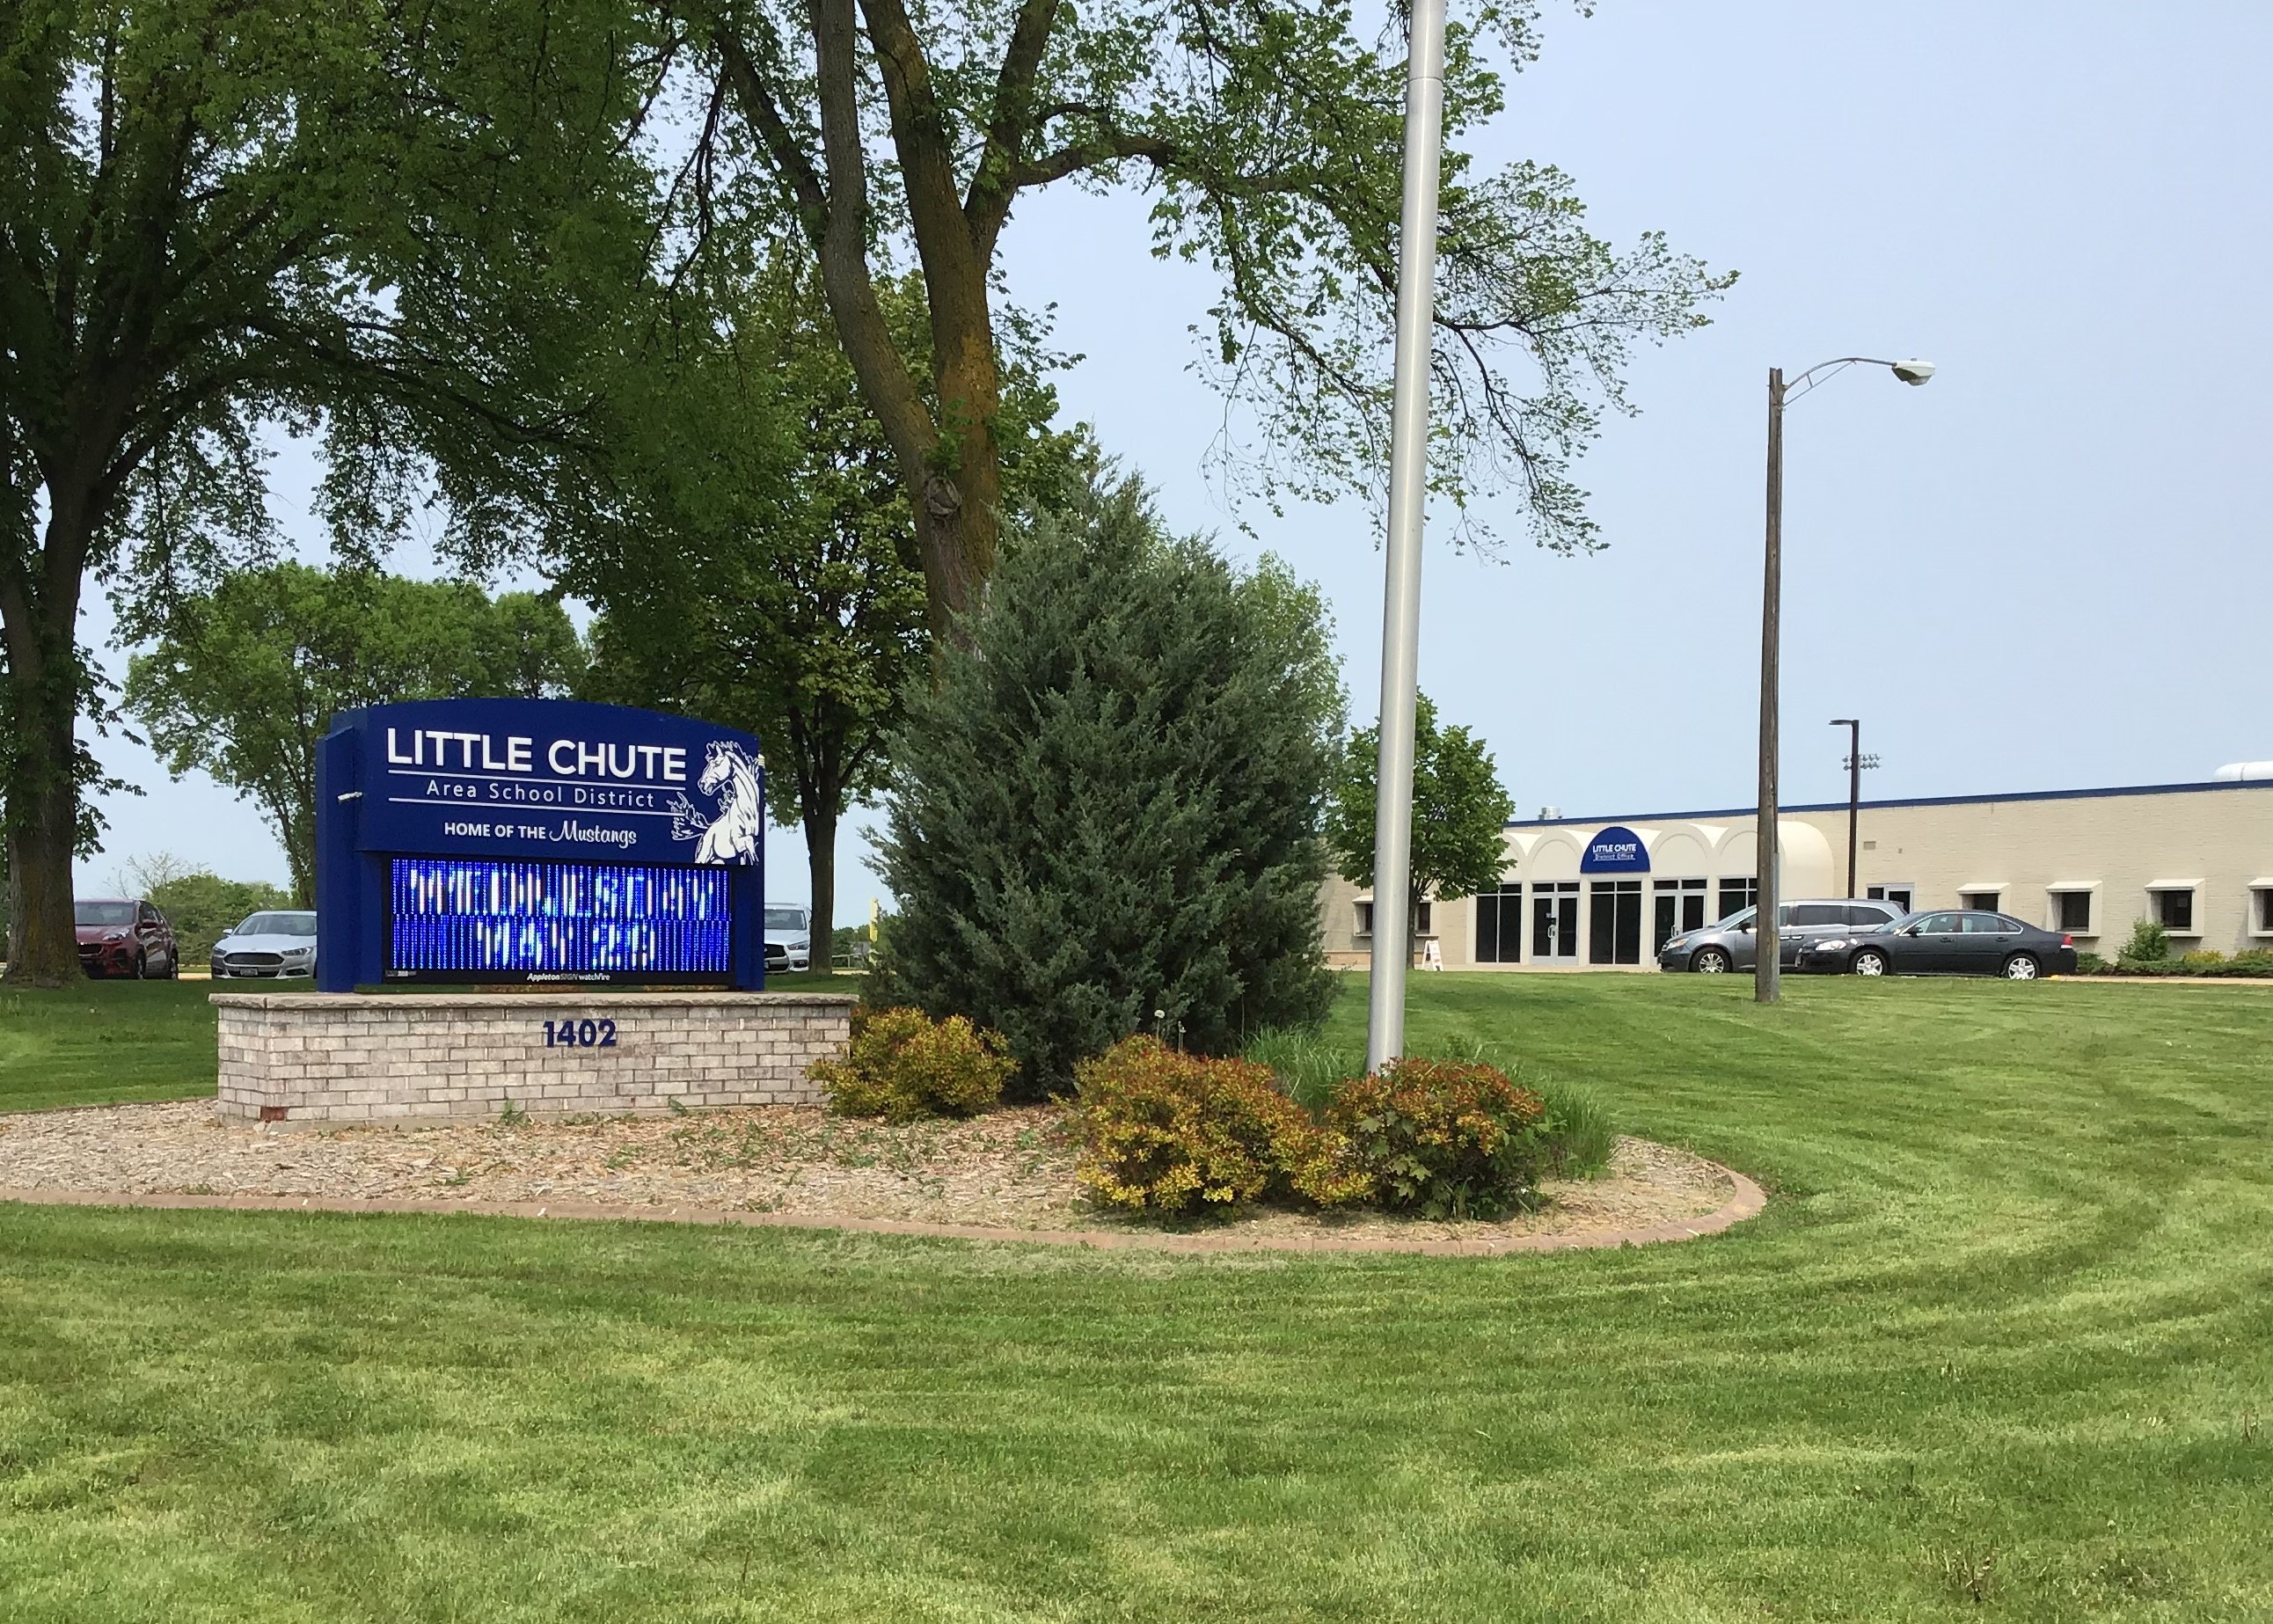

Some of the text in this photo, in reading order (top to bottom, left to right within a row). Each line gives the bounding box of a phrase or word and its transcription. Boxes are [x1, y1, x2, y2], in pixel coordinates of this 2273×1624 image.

[388, 728, 686, 781] LITTLE CHUTE
[427, 779, 654, 808] Area School District
[444, 820, 637, 849] HOME OF THE Mustangs
[543, 1019, 617, 1048] 1402
